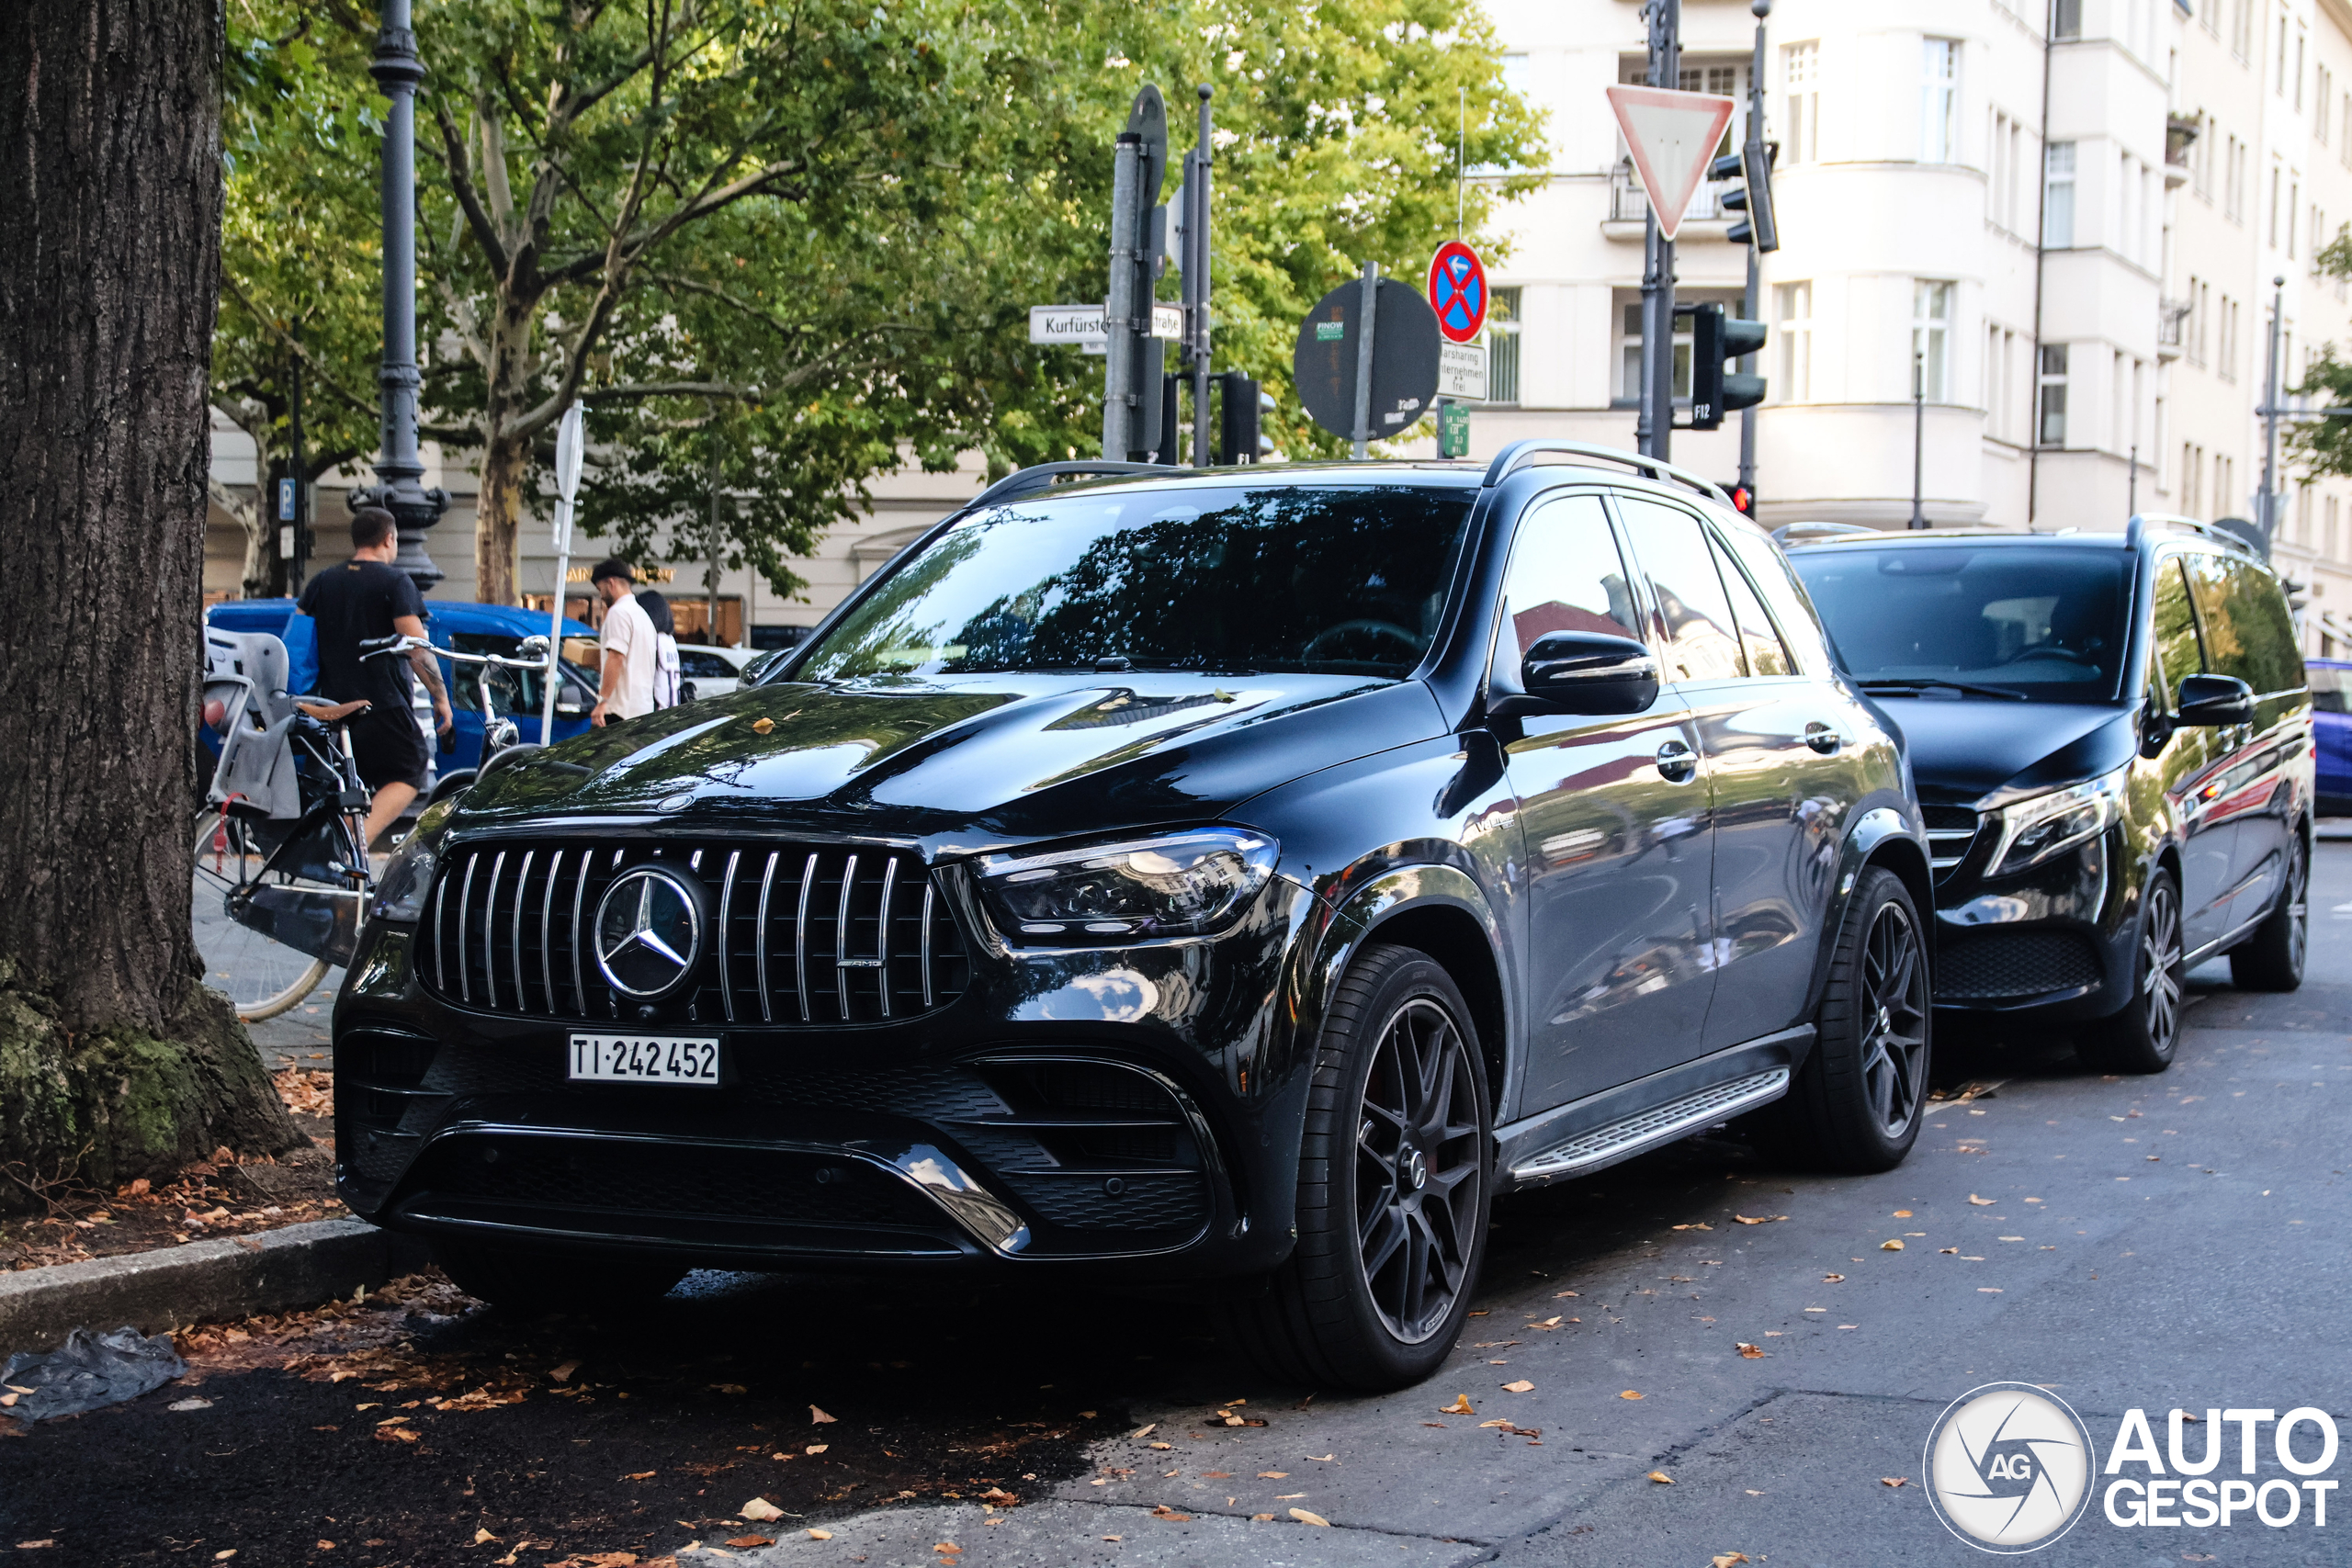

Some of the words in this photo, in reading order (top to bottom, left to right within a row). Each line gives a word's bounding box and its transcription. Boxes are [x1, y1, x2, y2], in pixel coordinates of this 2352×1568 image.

[1153, 313, 1179, 333] traße
[1317, 321, 1344, 330] FINOW
[1442, 348, 1478, 366] arsharing
[1453, 379, 1465, 392] frei
[1694, 403, 1710, 420] F12
